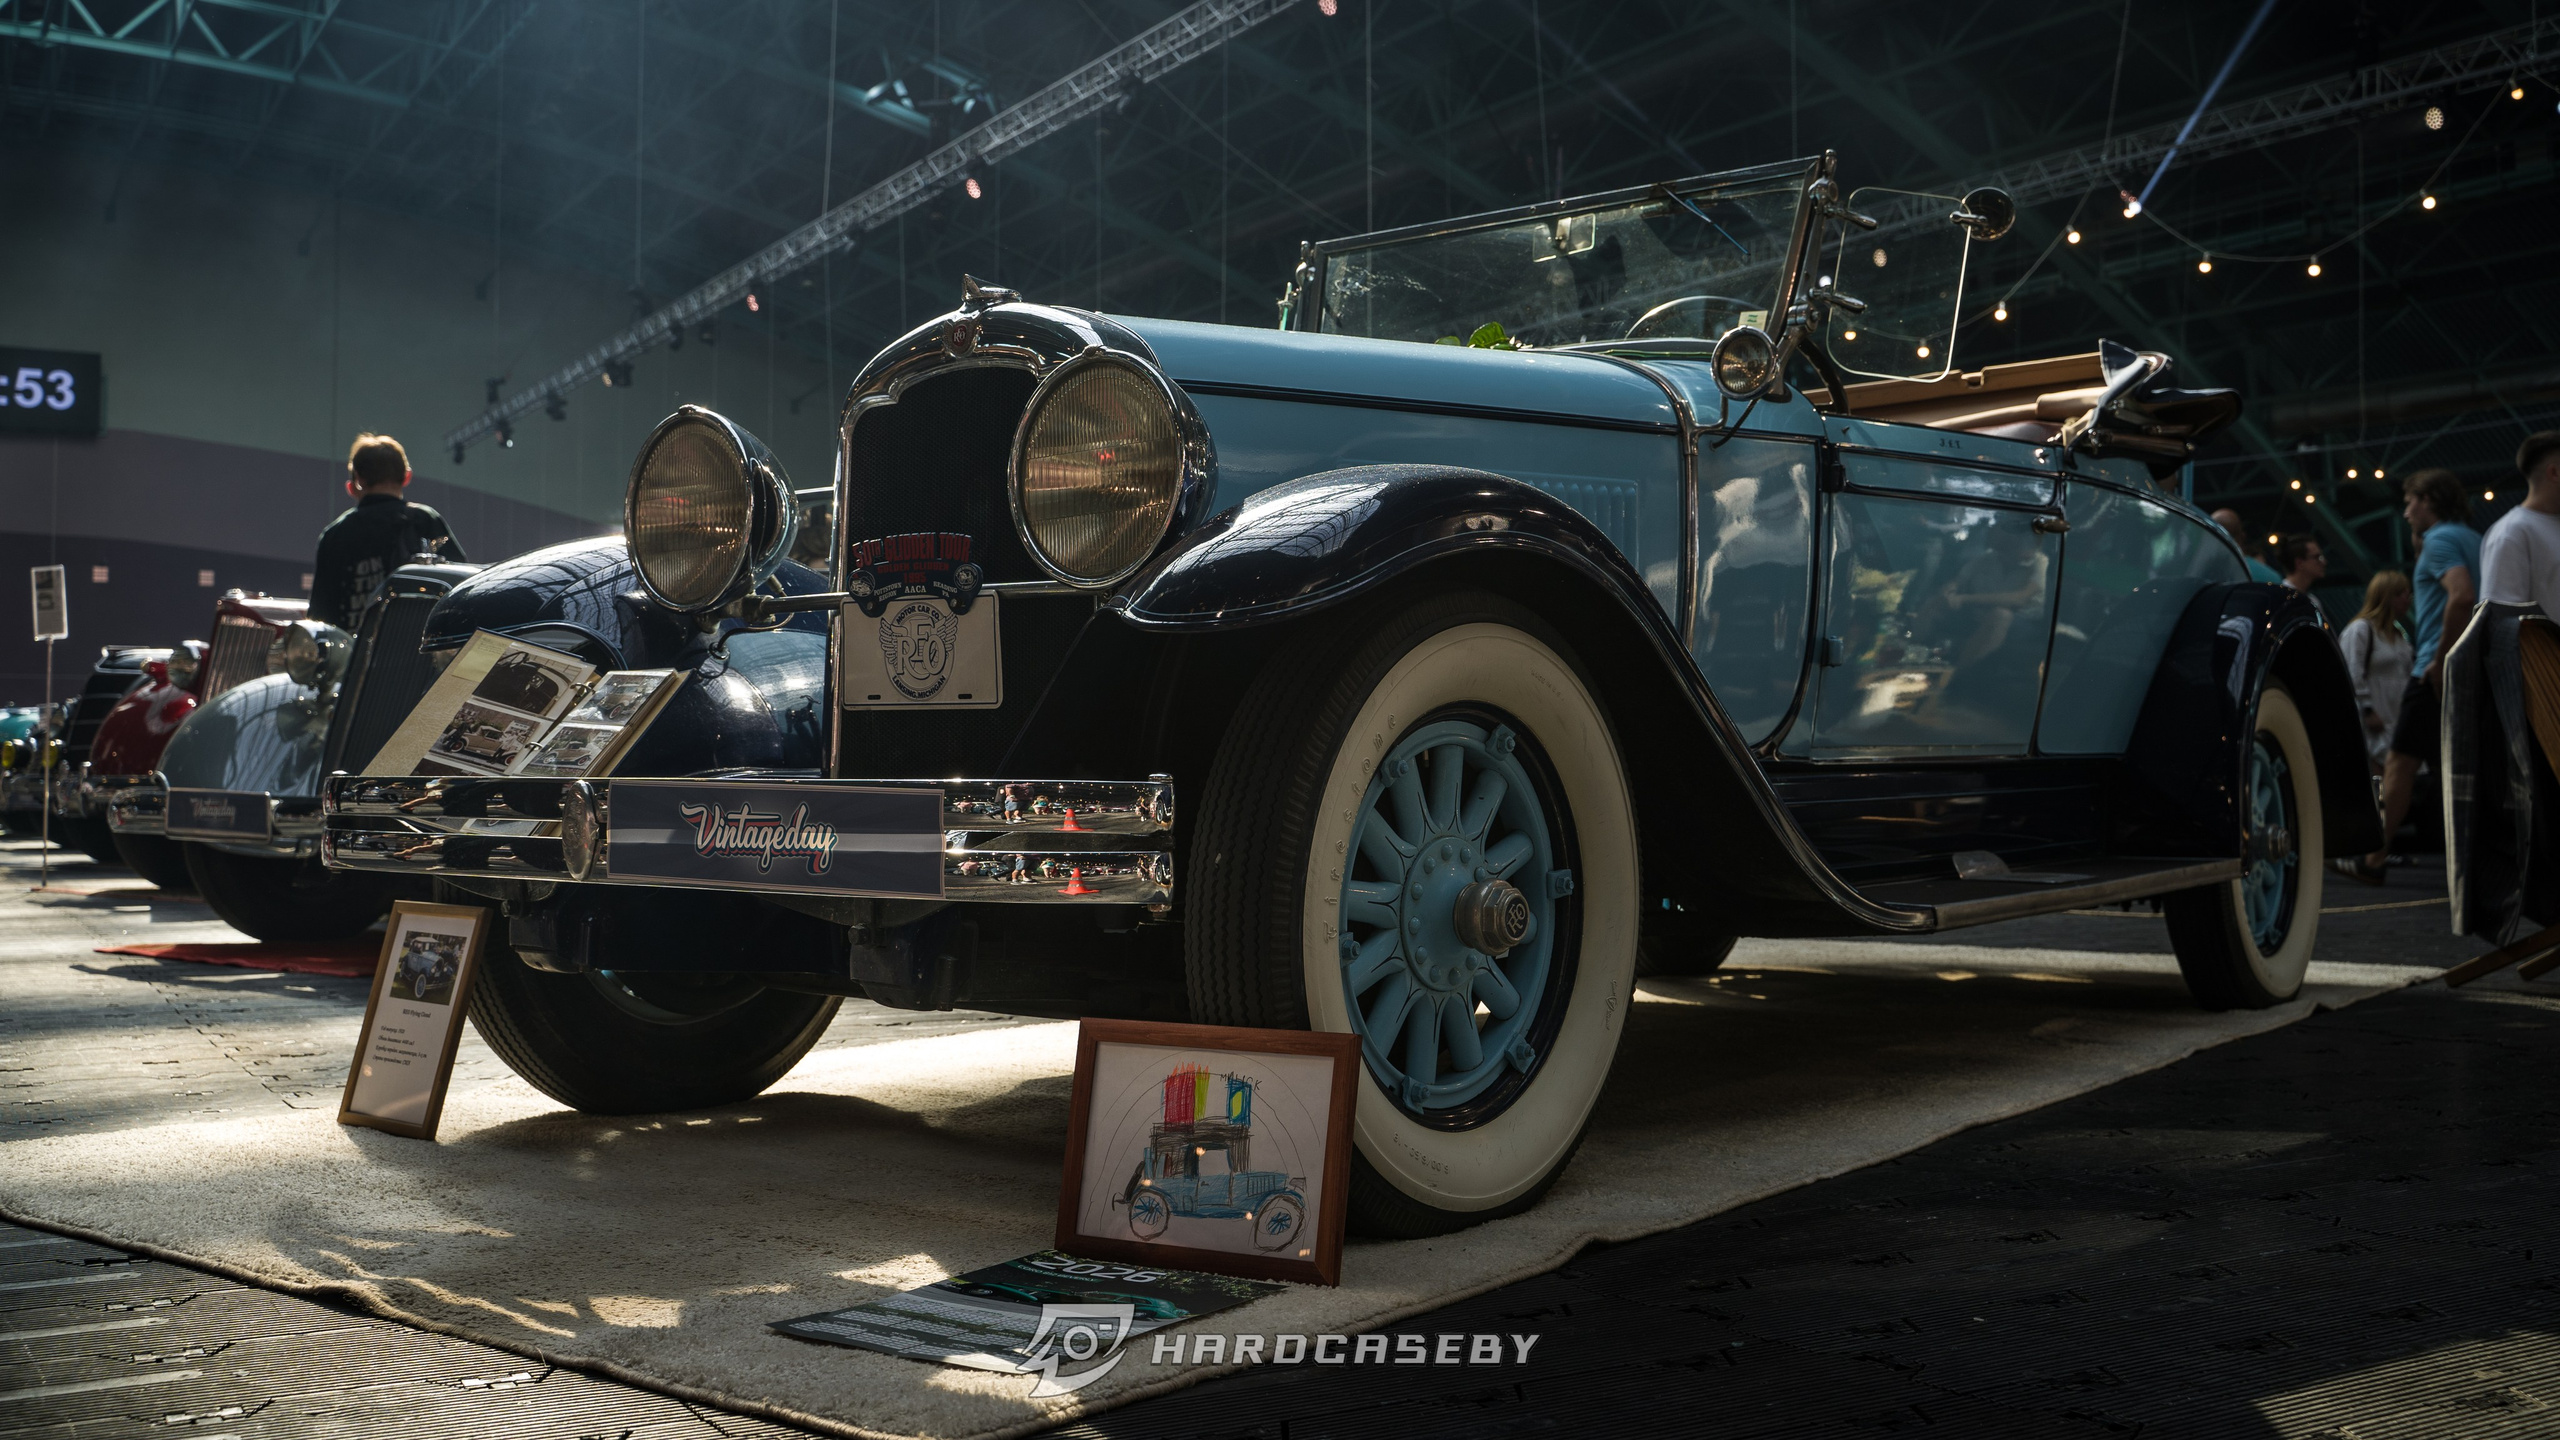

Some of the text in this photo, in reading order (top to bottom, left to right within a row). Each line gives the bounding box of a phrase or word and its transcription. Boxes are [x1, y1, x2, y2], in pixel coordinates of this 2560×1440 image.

[884, 532, 936, 562] GLIDDEN
[938, 532, 972, 563] TOUR
[877, 563, 910, 574] GOLDEN
[913, 562, 949, 571] GLIDDEN
[904, 572, 927, 584] 1995
[874, 582, 902, 596] POTTSTOWN
[879, 590, 897, 602] REGION
[904, 585, 927, 594] AACA
[933, 581, 958, 594] READING
[896, 606, 917, 625] MOTOR
[917, 605, 931, 614] CAR
[891, 617, 947, 680] REO
[917, 675, 946, 699] MICHIGAN
[680, 802, 837, 873] Vintageday
[1507, 903, 1526, 935] REO
[1031, 1255, 1167, 1283] 2026
